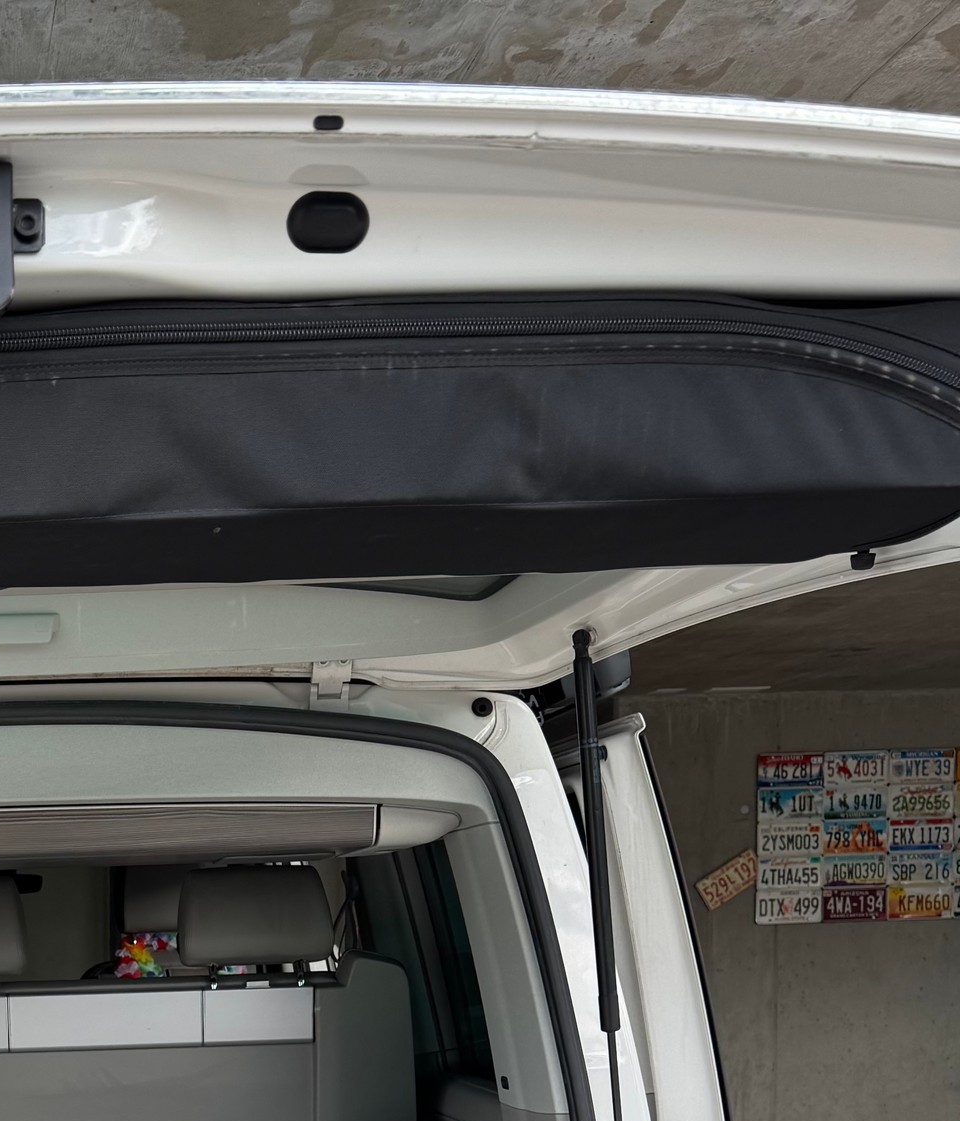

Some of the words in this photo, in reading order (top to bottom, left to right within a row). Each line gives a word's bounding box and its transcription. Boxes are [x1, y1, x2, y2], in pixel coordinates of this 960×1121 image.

[827, 760, 835, 777] 5
[935, 759, 951, 776] 39
[854, 794, 882, 810] 9470
[762, 834, 819, 851] 2YSM003
[826, 831, 850, 849] 798
[892, 827, 915, 845] EKX
[920, 827, 949, 844] 1173
[761, 867, 819, 885] 4THA455
[832, 862, 885, 880] AGW0390
[892, 864, 916, 881] SBP
[925, 863, 950, 880] 216
[794, 897, 819, 915] 499
[827, 895, 883, 914] 4WA-194
[899, 893, 950, 912] KFM660
